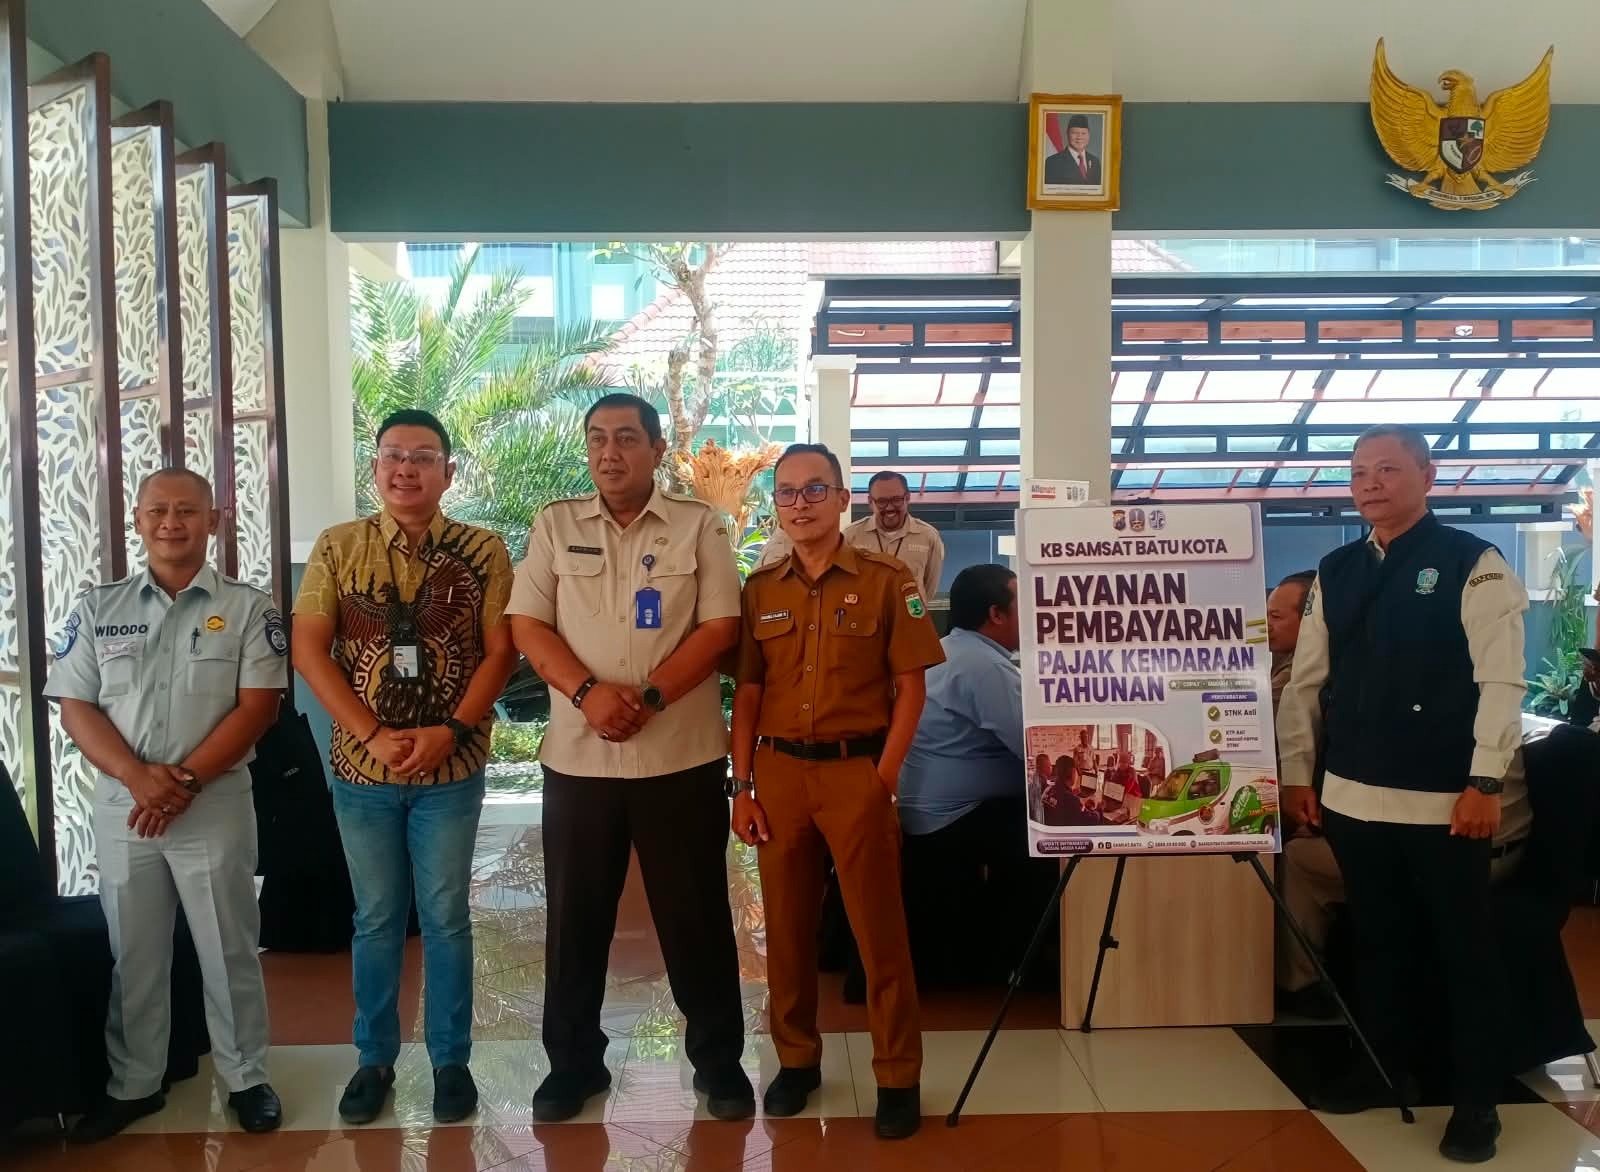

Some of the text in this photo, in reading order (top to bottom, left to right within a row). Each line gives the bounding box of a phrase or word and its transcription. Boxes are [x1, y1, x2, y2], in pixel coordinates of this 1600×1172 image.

[1040, 538, 1228, 558] KB SAMSAT BATU KOTA
[1034, 572, 1187, 607] LAYANAN
[95, 623, 148, 637] WIDODO
[1036, 607, 1244, 645] PEMBAYARAN
[1038, 646, 1255, 675] PAJAK KENDARAAN
[1039, 675, 1166, 704] TAHUNAN
[1224, 708, 1257, 717] STNK Asli
